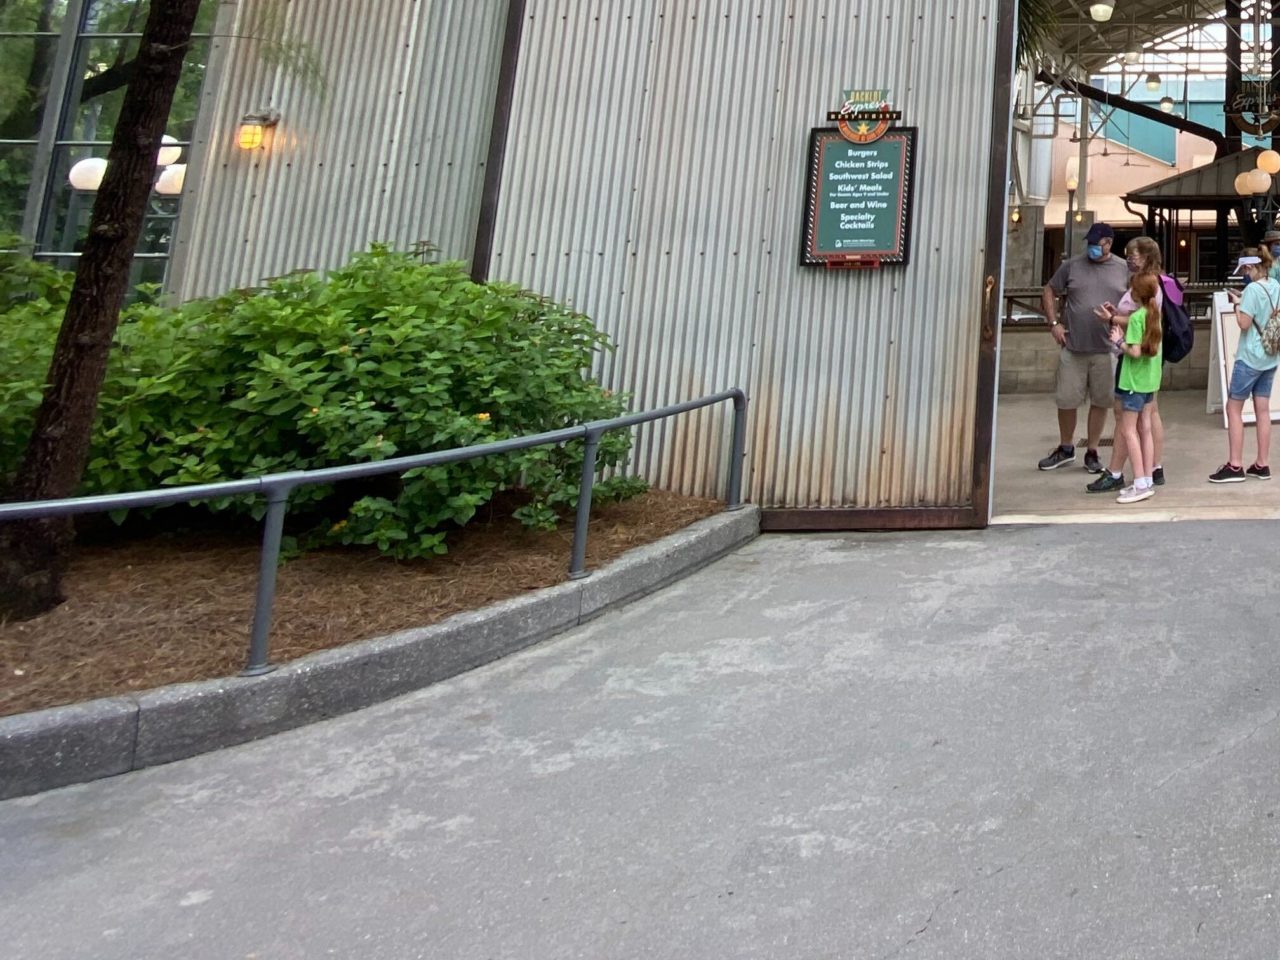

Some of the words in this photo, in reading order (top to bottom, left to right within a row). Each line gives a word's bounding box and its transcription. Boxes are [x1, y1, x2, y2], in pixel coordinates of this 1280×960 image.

[841, 99, 894, 116] Express
[847, 149, 878, 158] Burgers
[835, 160, 865, 168] Chicken
[867, 160, 889, 170] Strips
[829, 172, 869, 180] Southwest
[871, 171, 893, 180] Salad
[859, 183, 882, 192] Meals
[830, 201, 848, 209] Beer
[849, 201, 865, 209] and
[866, 201, 888, 209] Wine
[840, 212, 876, 222] Specialty
[840, 221, 875, 229] Cocktails
